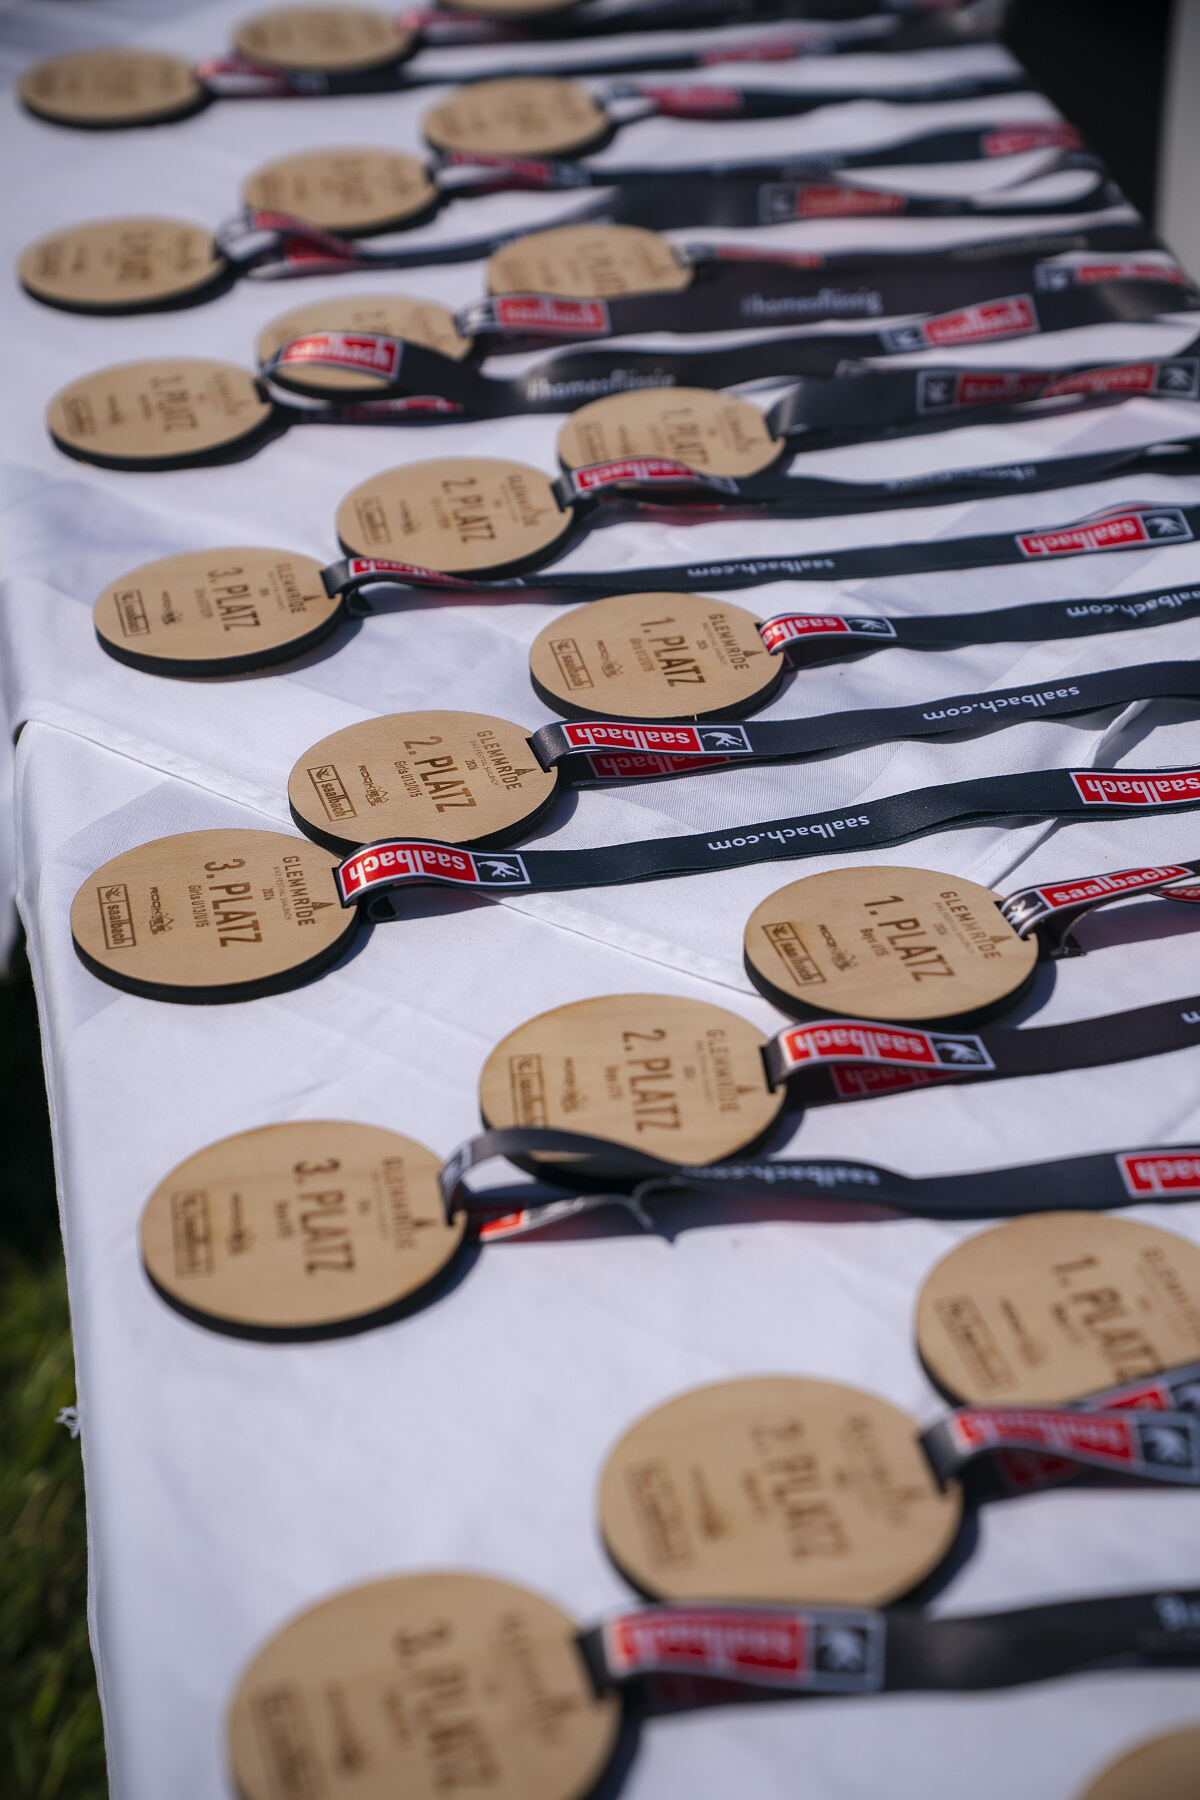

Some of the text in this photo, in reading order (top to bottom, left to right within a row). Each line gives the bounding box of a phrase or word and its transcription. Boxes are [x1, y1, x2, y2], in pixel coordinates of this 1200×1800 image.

[452, 494, 497, 543] PLATZ
[1029, 519, 1137, 554] saalbach
[687, 558, 836, 578] saalbach.com
[207, 567, 261, 631] 3. PLATZ
[1066, 589, 1200, 618] aalbach.com
[708, 613, 750, 671] GLEMMRIDE
[761, 616, 838, 646] saalba
[640, 616, 706, 687] 1. PLATZ
[923, 685, 1081, 721] saalbach.com
[576, 727, 691, 750] saalbach
[402, 735, 478, 813] 2. PLATZ
[476, 730, 523, 790] GLEMMRIDE
[321, 782, 347, 819] saalbach
[1086, 776, 1200, 804] saalbach
[707, 815, 871, 851] saalbach.com
[348, 850, 467, 887] saalbach
[1052, 866, 1177, 902] saalbach
[203, 858, 264, 947] 3. PLATZ
[282, 855, 316, 927] GLEMMRIDE
[863, 895, 905, 917] 1.
[107, 904, 128, 945] saalbach
[939, 890, 1003, 960] GLEMMRIDE
[877, 917, 958, 982] PLATZ
[794, 1028, 925, 1060] saalbach
[622, 1028, 683, 1133] 2. PLATZ
[293, 1157, 357, 1276] 3. PLATZ
